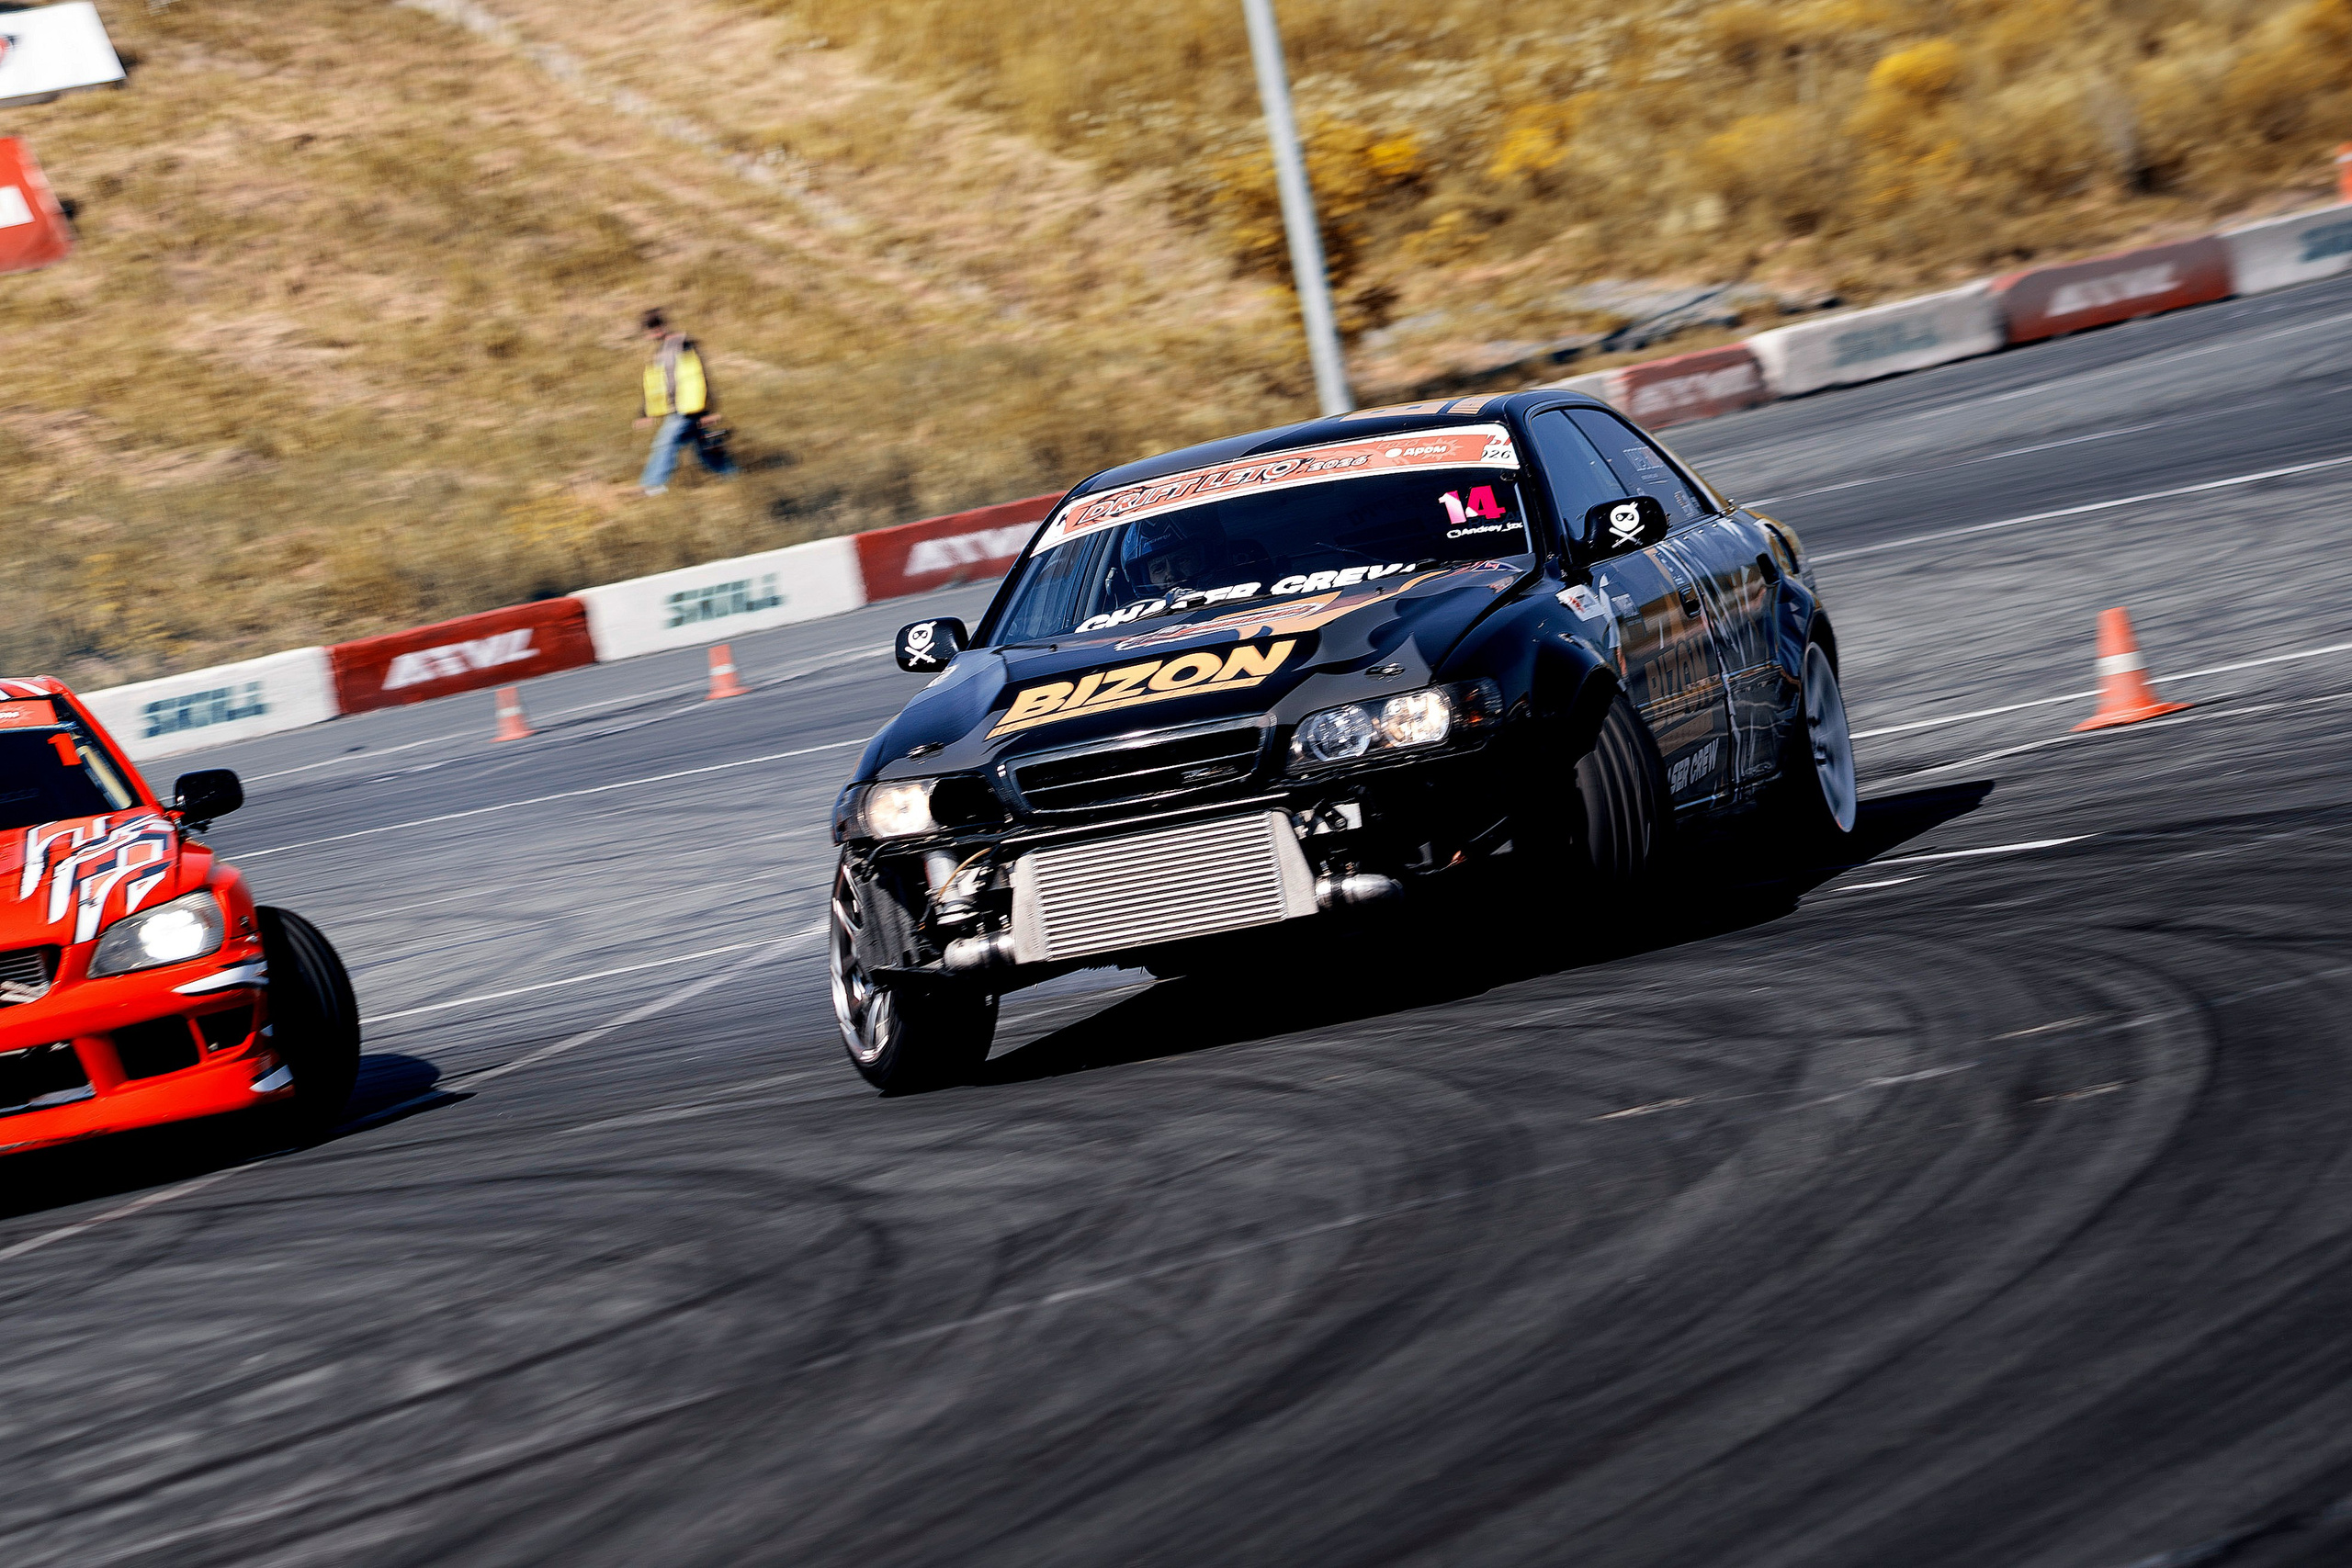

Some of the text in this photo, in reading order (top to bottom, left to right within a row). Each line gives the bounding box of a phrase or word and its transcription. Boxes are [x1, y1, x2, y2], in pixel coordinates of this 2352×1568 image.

[1076, 477, 1202, 526] DRIFT
[1194, 457, 1306, 493] LETO
[1437, 484, 1507, 525] 14
[994, 639, 1297, 728] BIZON
[1667, 756, 1691, 795] SER
[1690, 737, 1719, 784] CREW
